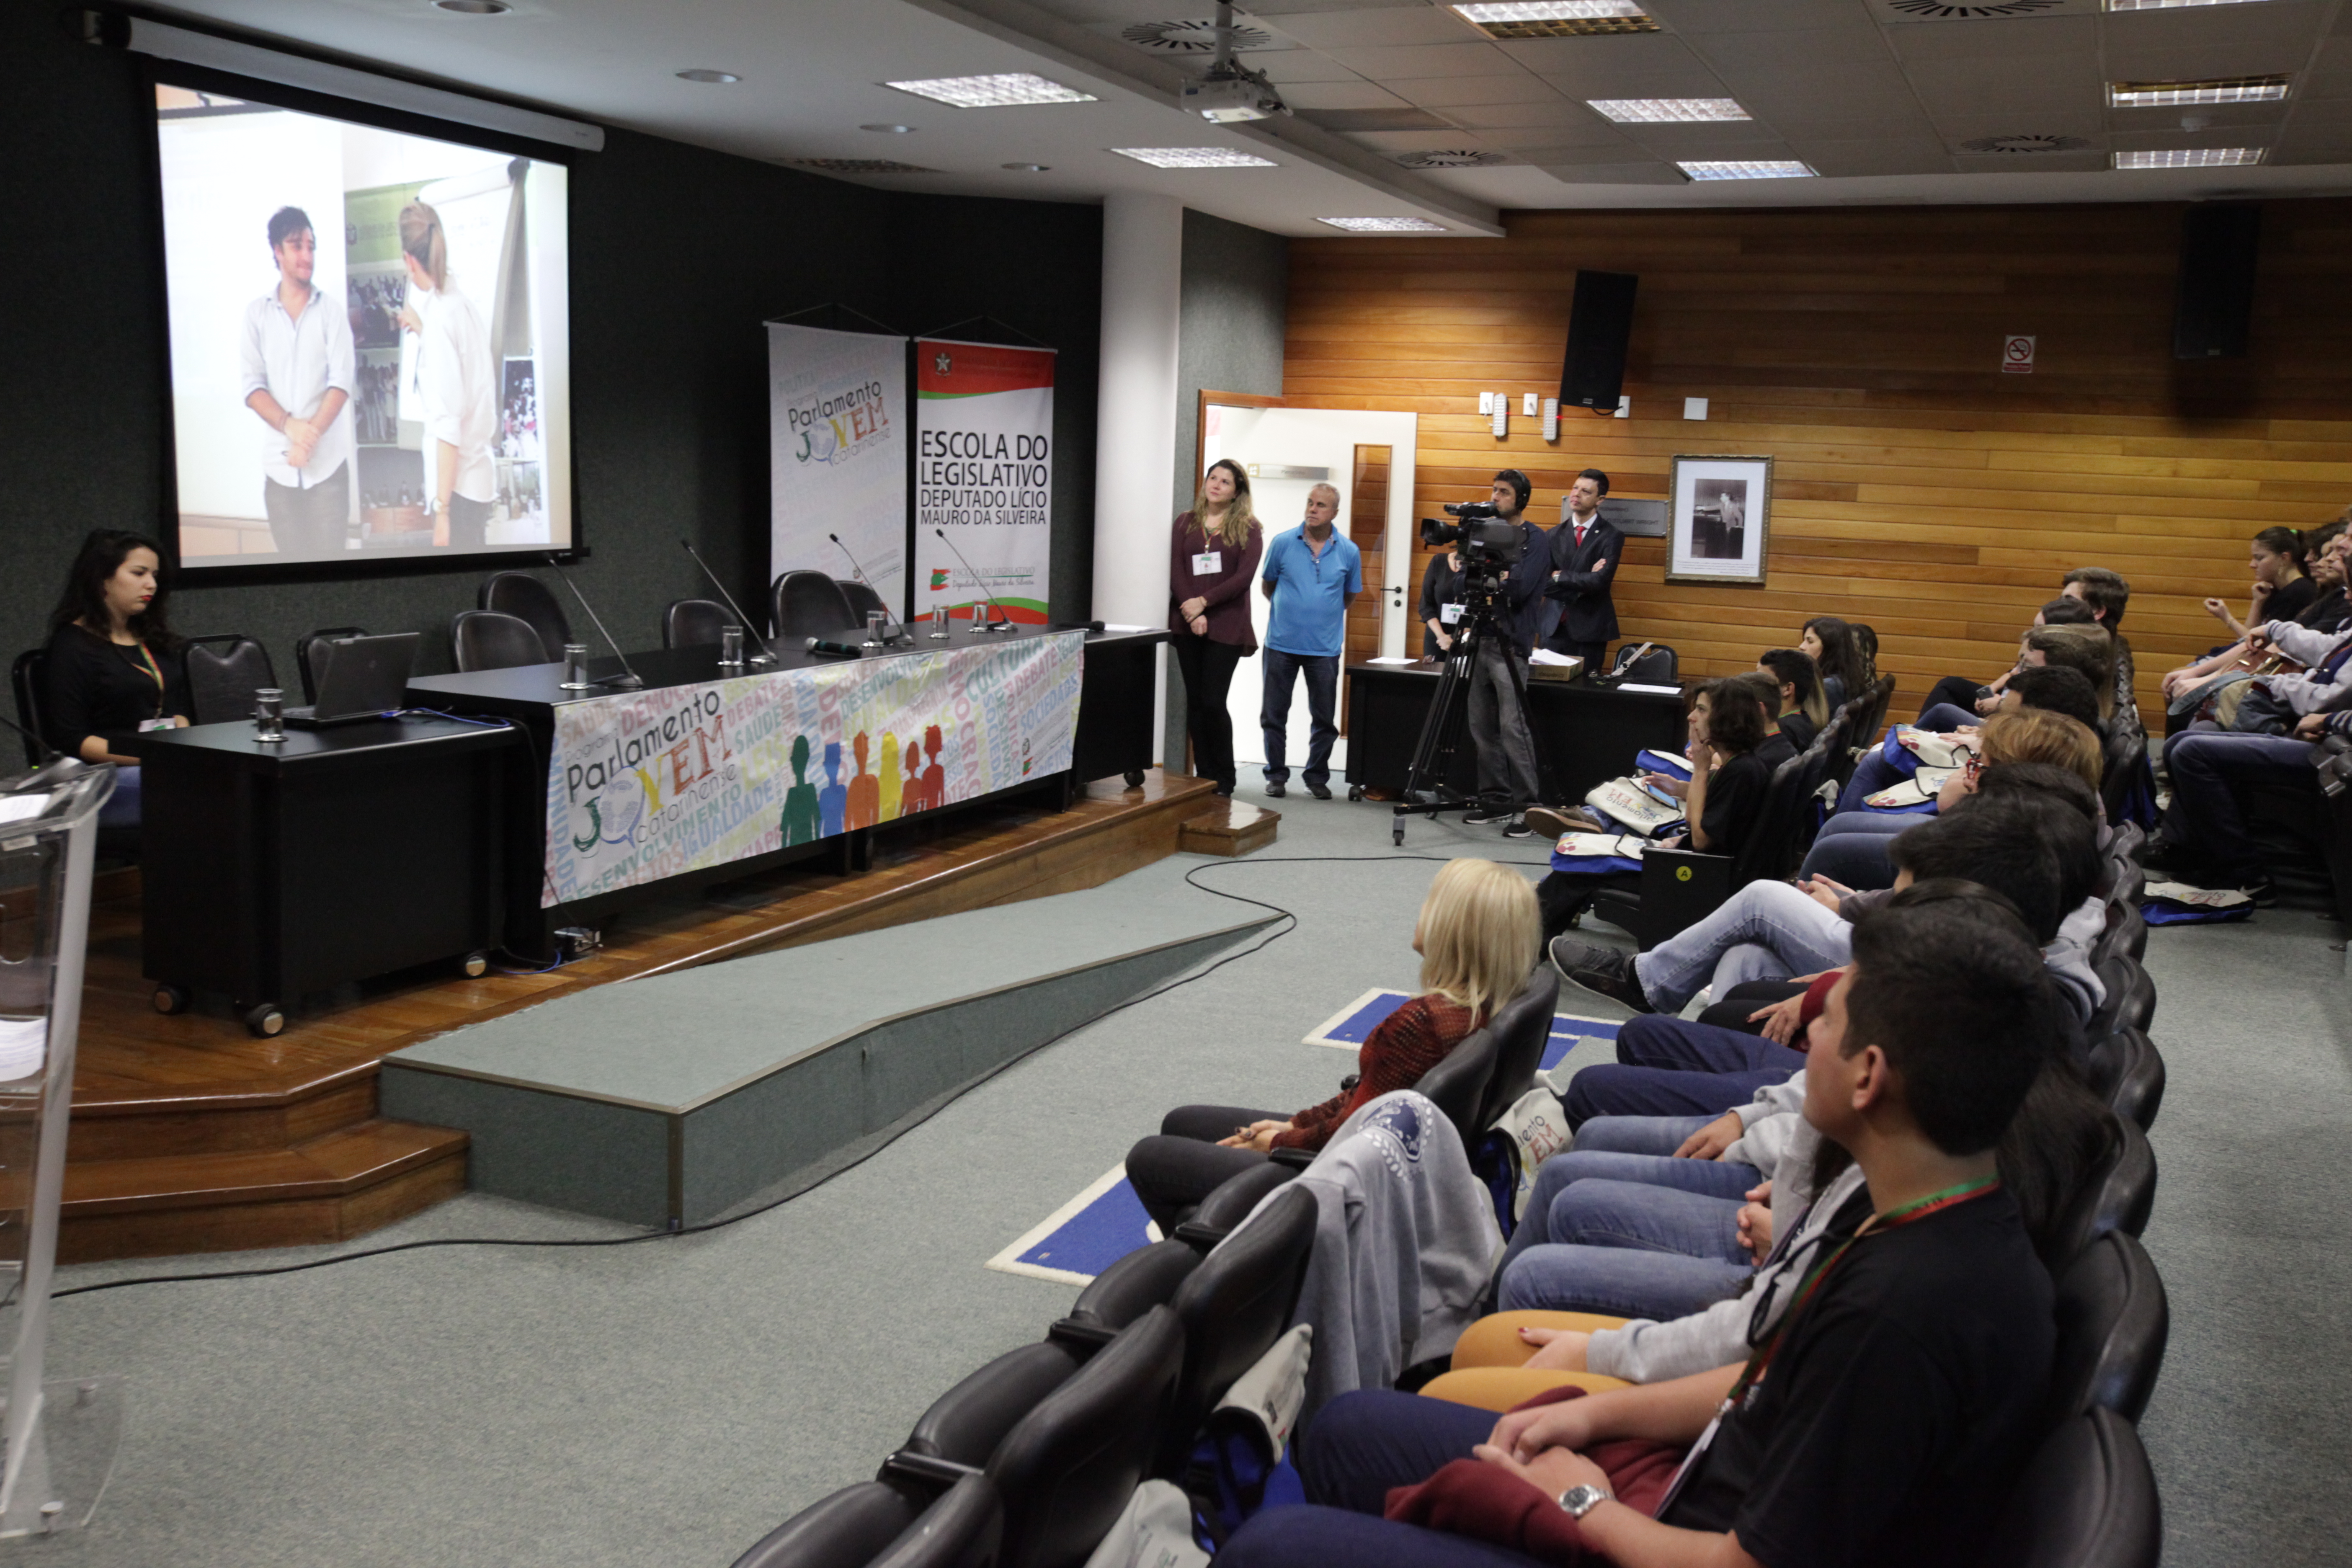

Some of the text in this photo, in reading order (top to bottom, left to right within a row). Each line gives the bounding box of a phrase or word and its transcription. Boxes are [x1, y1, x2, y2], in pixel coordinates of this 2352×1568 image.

[788, 381, 882, 432] Parlamento
[796, 396, 889, 463] JOVEM
[921, 430, 1048, 461] ESCOLA DO
[921, 462, 1047, 487] LEGISLATIVO
[921, 487, 1047, 508] DEPUTADO LÍCIO
[921, 510, 1046, 524] MAURO DA SILVEIRA
[1015, 646, 1058, 697] DEBATE
[727, 678, 780, 728] DEBATE
[567, 691, 720, 803] Parlamento
[573, 714, 732, 853] JOVEM
[636, 763, 737, 843] catarinense
[682, 779, 773, 862] IGUALDADE
[1680, 869, 1689, 878] A
